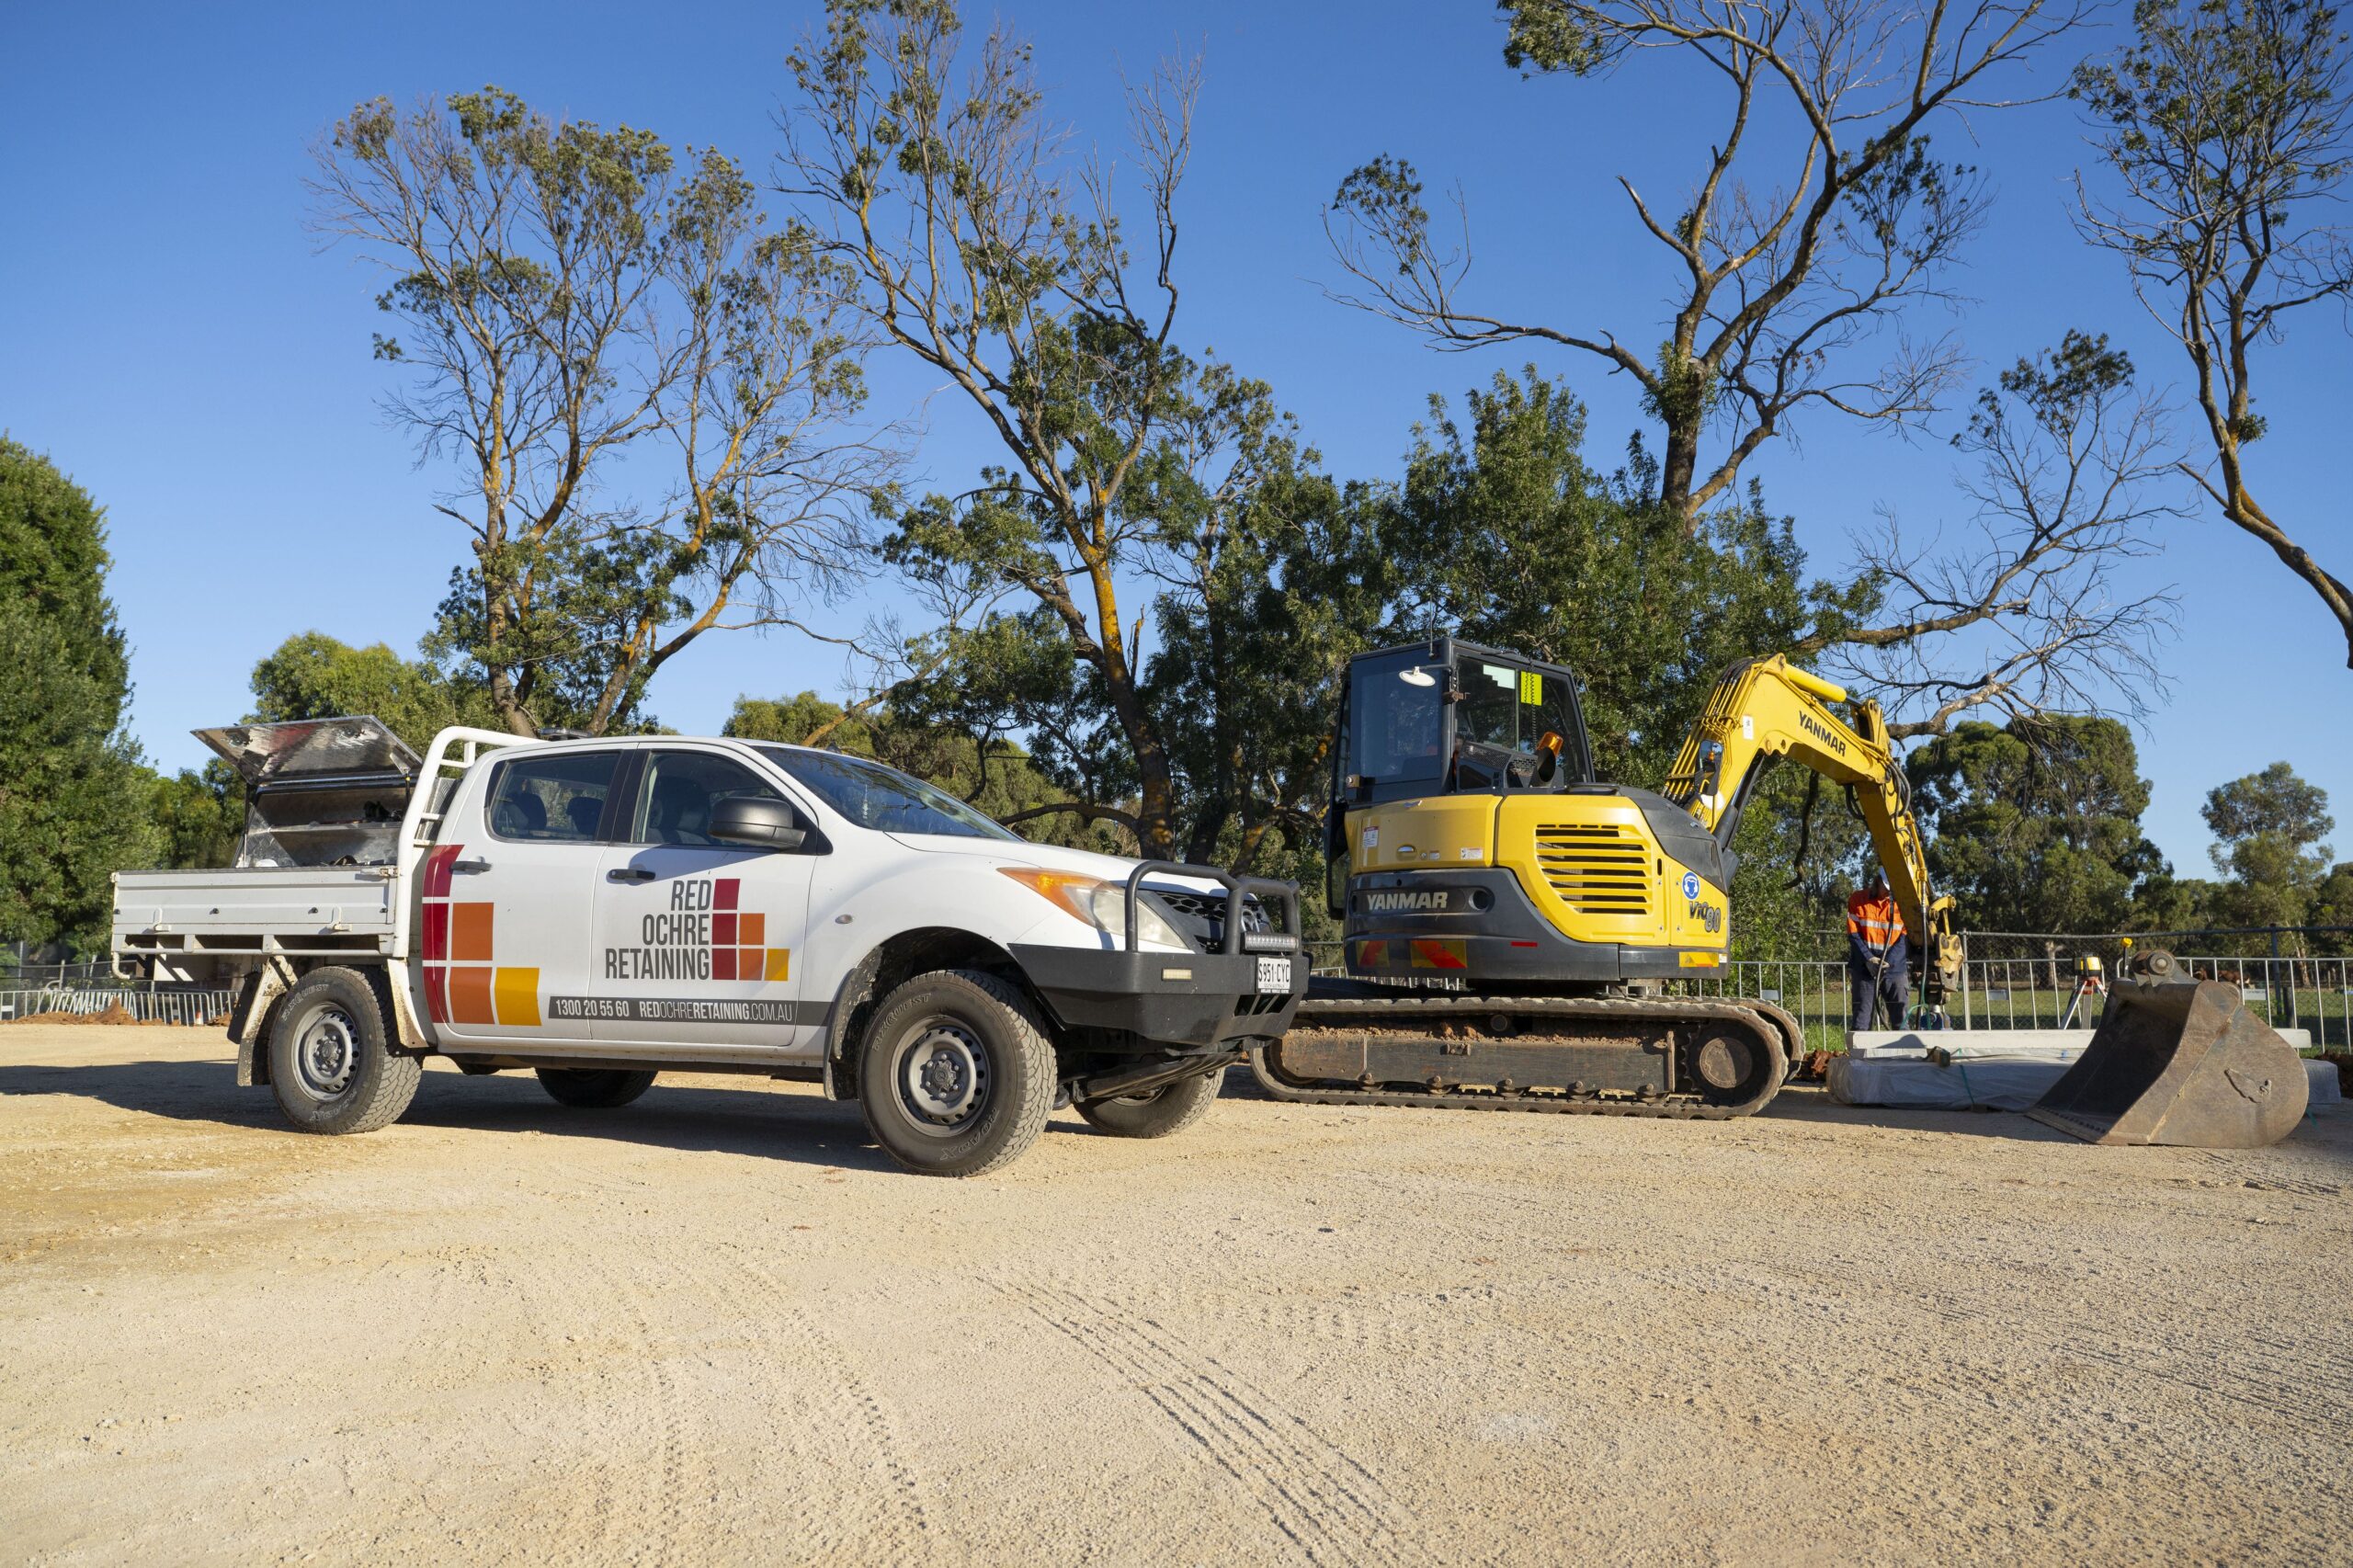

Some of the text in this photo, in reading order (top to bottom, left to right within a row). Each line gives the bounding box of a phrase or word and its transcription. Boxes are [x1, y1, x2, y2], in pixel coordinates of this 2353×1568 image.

[1799, 710, 1847, 756] YANMAR
[670, 880, 712, 911] RED
[1367, 892, 1449, 911] YANMAR
[642, 914, 710, 946] OCHRE
[605, 948, 710, 981] RETAINING
[556, 999, 792, 1022] 1300 20 55 60 REDOCHRERETAINING.COM.AU
